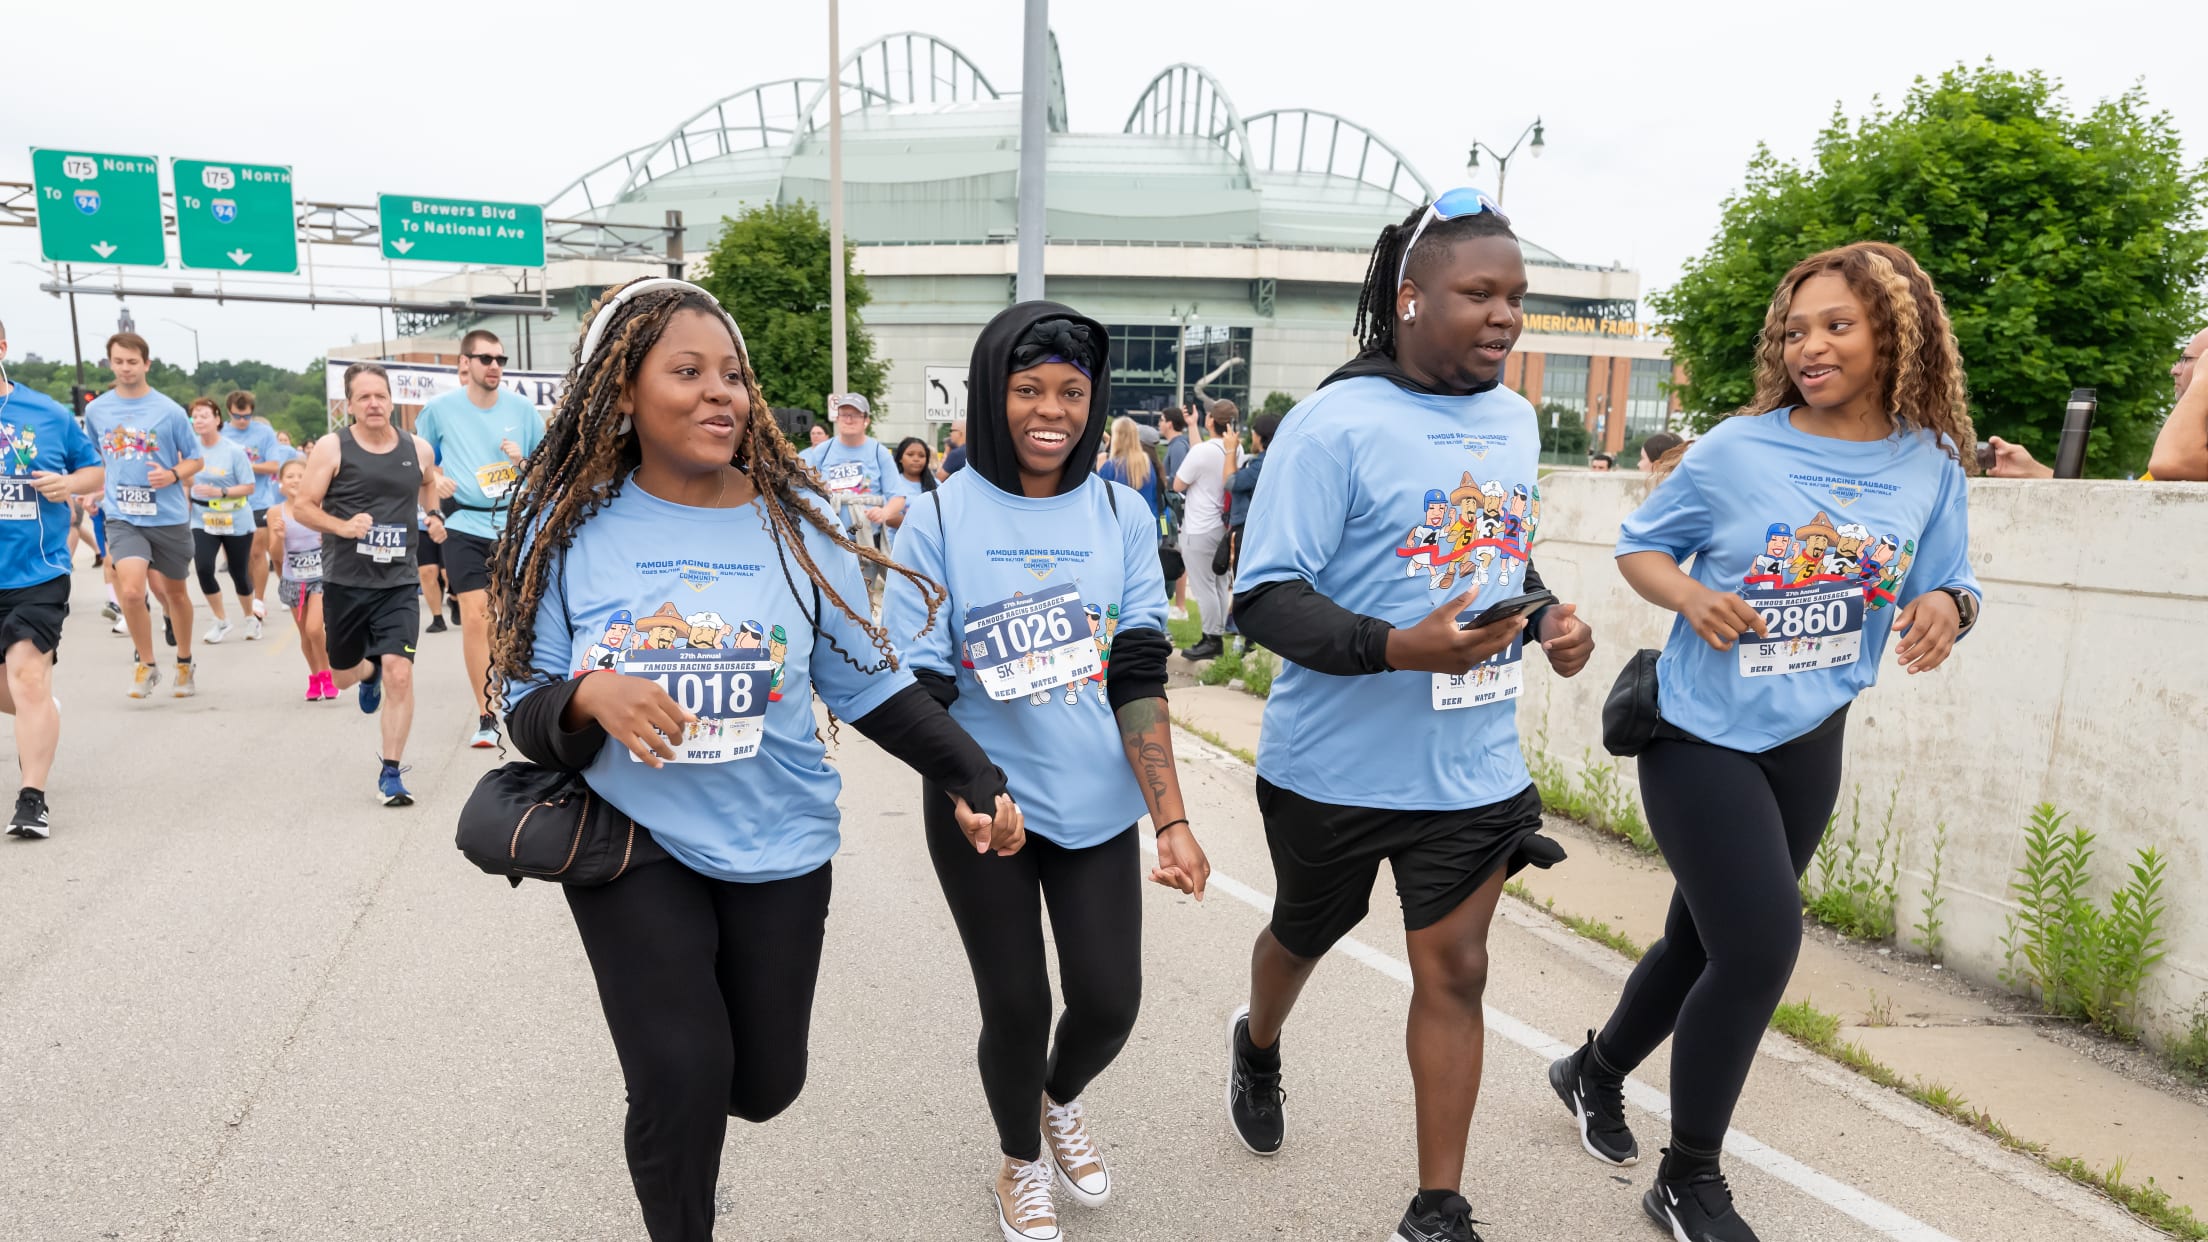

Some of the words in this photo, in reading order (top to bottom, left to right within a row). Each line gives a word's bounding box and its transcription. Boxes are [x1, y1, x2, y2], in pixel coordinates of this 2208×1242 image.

[68, 162, 93, 176] 175
[103, 159, 155, 174] NORTH
[206, 171, 230, 186] 175
[241, 168, 291, 184] NORTH
[78, 197, 97, 209] 94
[412, 200, 476, 217] Brewers
[482, 205, 517, 220] Blvd
[216, 206, 234, 218] 94
[401, 219, 420, 233] To
[424, 221, 492, 237] National
[496, 226, 525, 240] Ave
[1522, 314, 1596, 332] AMERICAN
[928, 408, 952, 417] ONLY
[1789, 474, 1823, 482] FAMOUS
[1826, 477, 1856, 485] RACING
[123, 490, 151, 503] 1283
[1829, 490, 1863, 498] COMMUNITY
[1483, 522, 1495, 539] 3
[1507, 519, 1519, 537] 2
[368, 530, 401, 547] 1414
[1423, 532, 1437, 545] 4
[1462, 530, 1472, 546] 5
[636, 561, 674, 569] FAMOUS
[676, 560, 710, 569] RACING
[1767, 562, 1780, 574] 4
[1803, 564, 1816, 579] 5
[1831, 562, 1846, 576] 3
[680, 573, 720, 582] COMMUNITY
[1786, 597, 1812, 605] RACING
[1813, 591, 1849, 602] SAUSAGES
[978, 613, 1005, 628] FAMOUS
[1006, 607, 1030, 619] RACING
[1030, 597, 1065, 612] SAUSAGES
[1759, 600, 1848, 640] 2860
[987, 607, 1073, 659] 1026
[1760, 644, 1777, 656] 5K
[598, 654, 615, 670] 4
[643, 663, 678, 671] FAMOUS
[680, 663, 711, 671] RACING
[1750, 665, 1773, 673] BEER
[1789, 661, 1818, 670] WATER
[1831, 654, 1852, 664] BRAT
[996, 663, 1015, 679] 5K
[995, 688, 1017, 698] BEER
[1031, 676, 1059, 689] WATER
[1071, 665, 1094, 678] BRAT
[1442, 697, 1463, 706] BEER
[1475, 692, 1496, 703] WATER
[688, 751, 722, 759] WATER
[733, 745, 755, 756] BRAT
